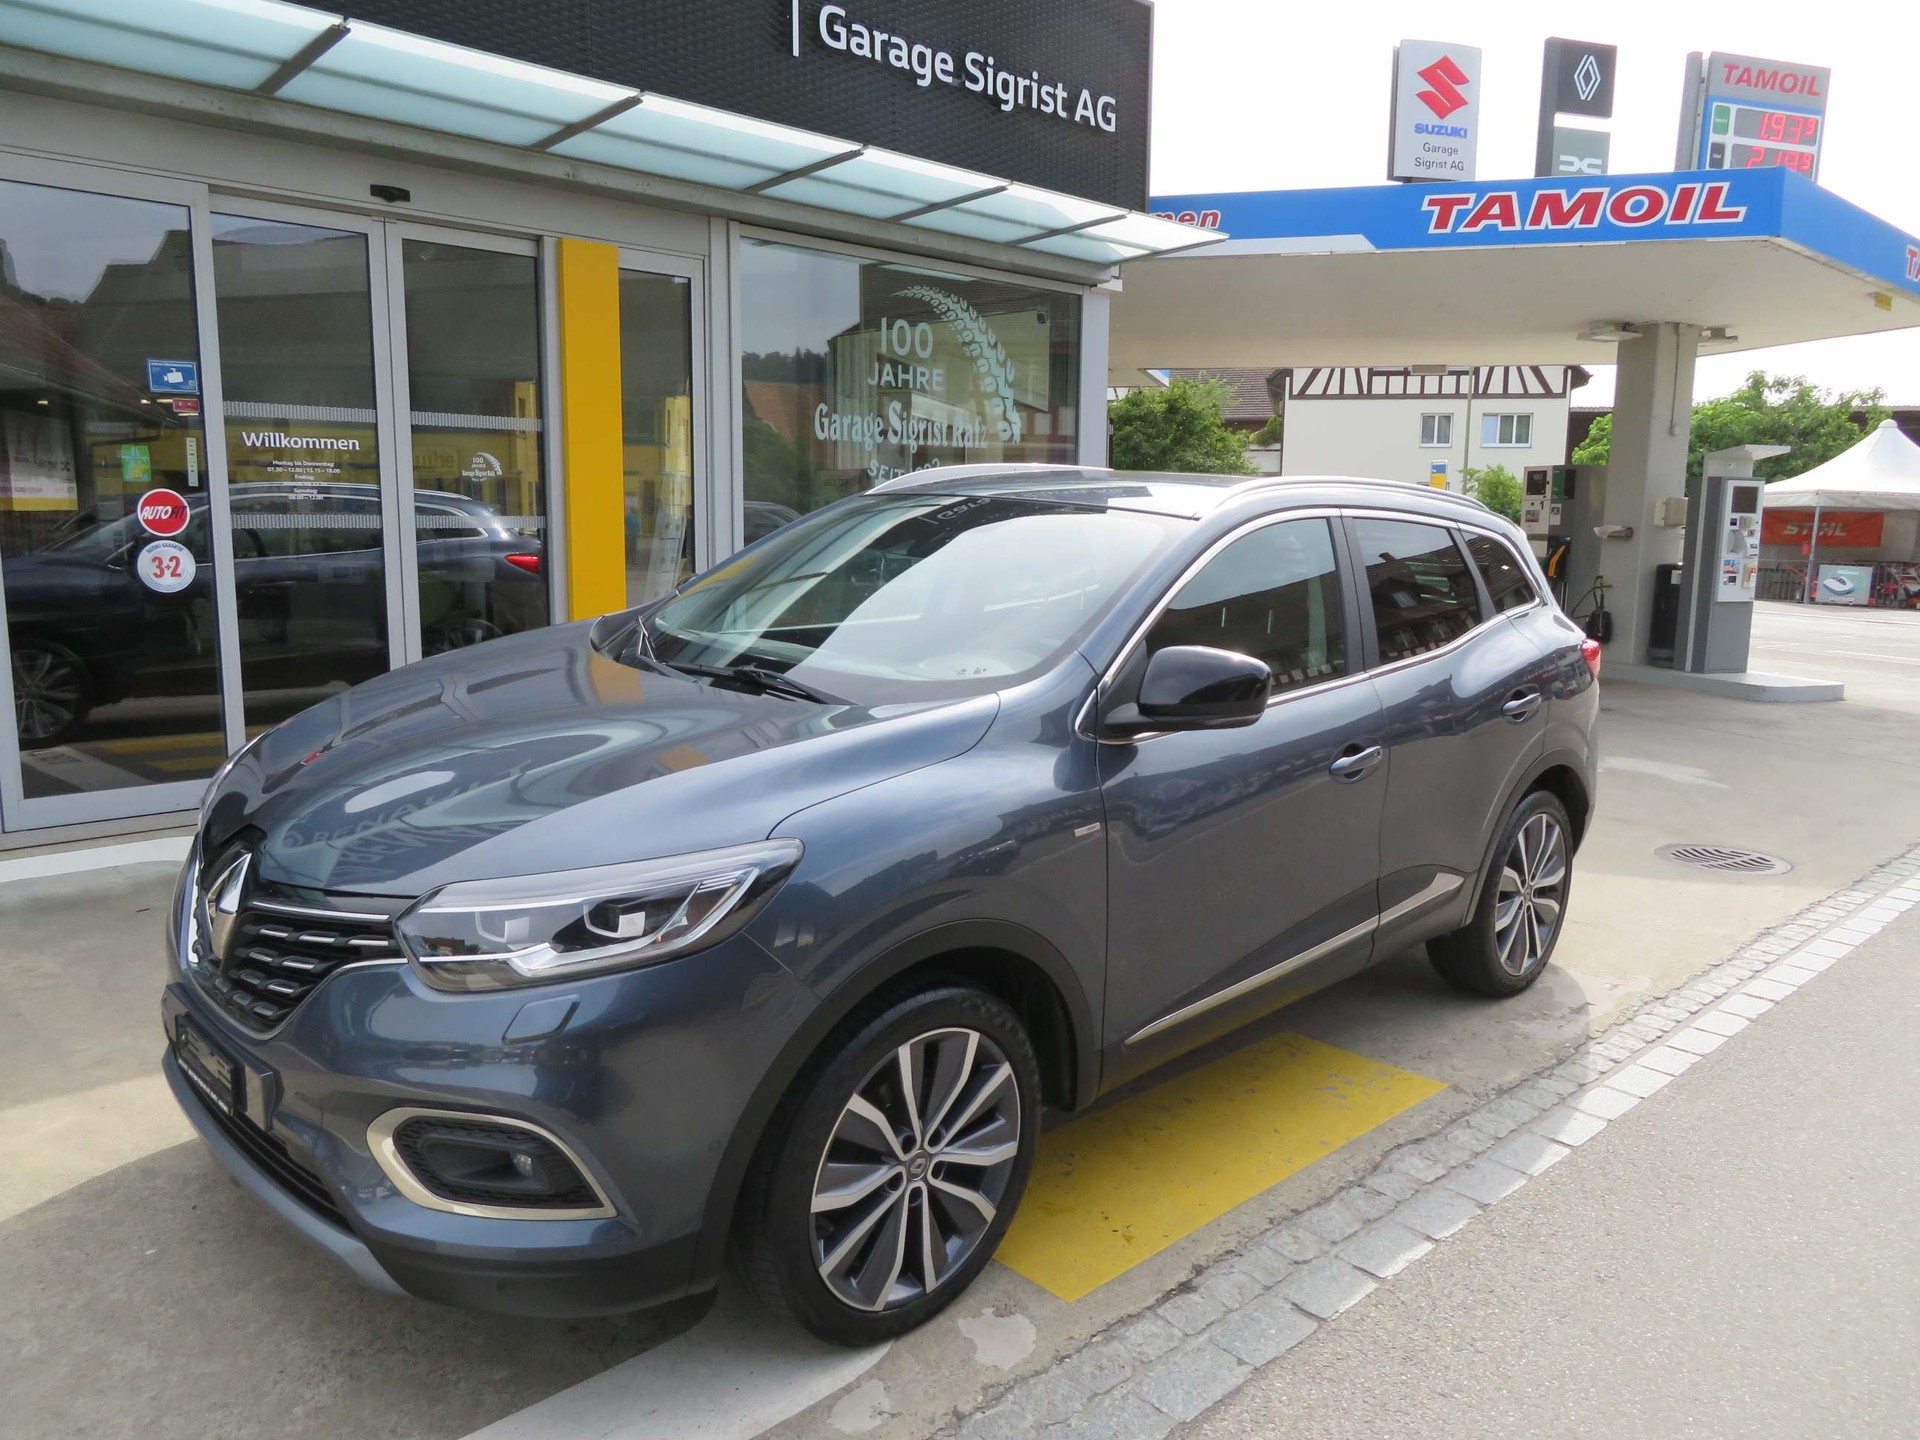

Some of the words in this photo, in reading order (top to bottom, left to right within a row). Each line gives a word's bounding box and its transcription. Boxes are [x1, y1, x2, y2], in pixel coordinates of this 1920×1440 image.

[818, 4, 954, 88] Garage
[964, 51, 1068, 119] Sigrist
[1073, 88, 1117, 133] AG
[1723, 63, 1821, 97] TAMOIL
[1414, 122, 1468, 139] SUZUKI
[1422, 141, 1459, 157] Garage
[1414, 156, 1448, 170] Sigrist
[1449, 159, 1465, 172] AG
[1420, 181, 1747, 235] TAMOIL
[880, 316, 934, 359] 100
[867, 361, 945, 392] JAHRE
[814, 402, 884, 450] Garage
[887, 400, 949, 454] Sigrist
[241, 431, 361, 451] Willkommen
[1783, 521, 1847, 537] STHL
[151, 555, 183, 579] 3+2
